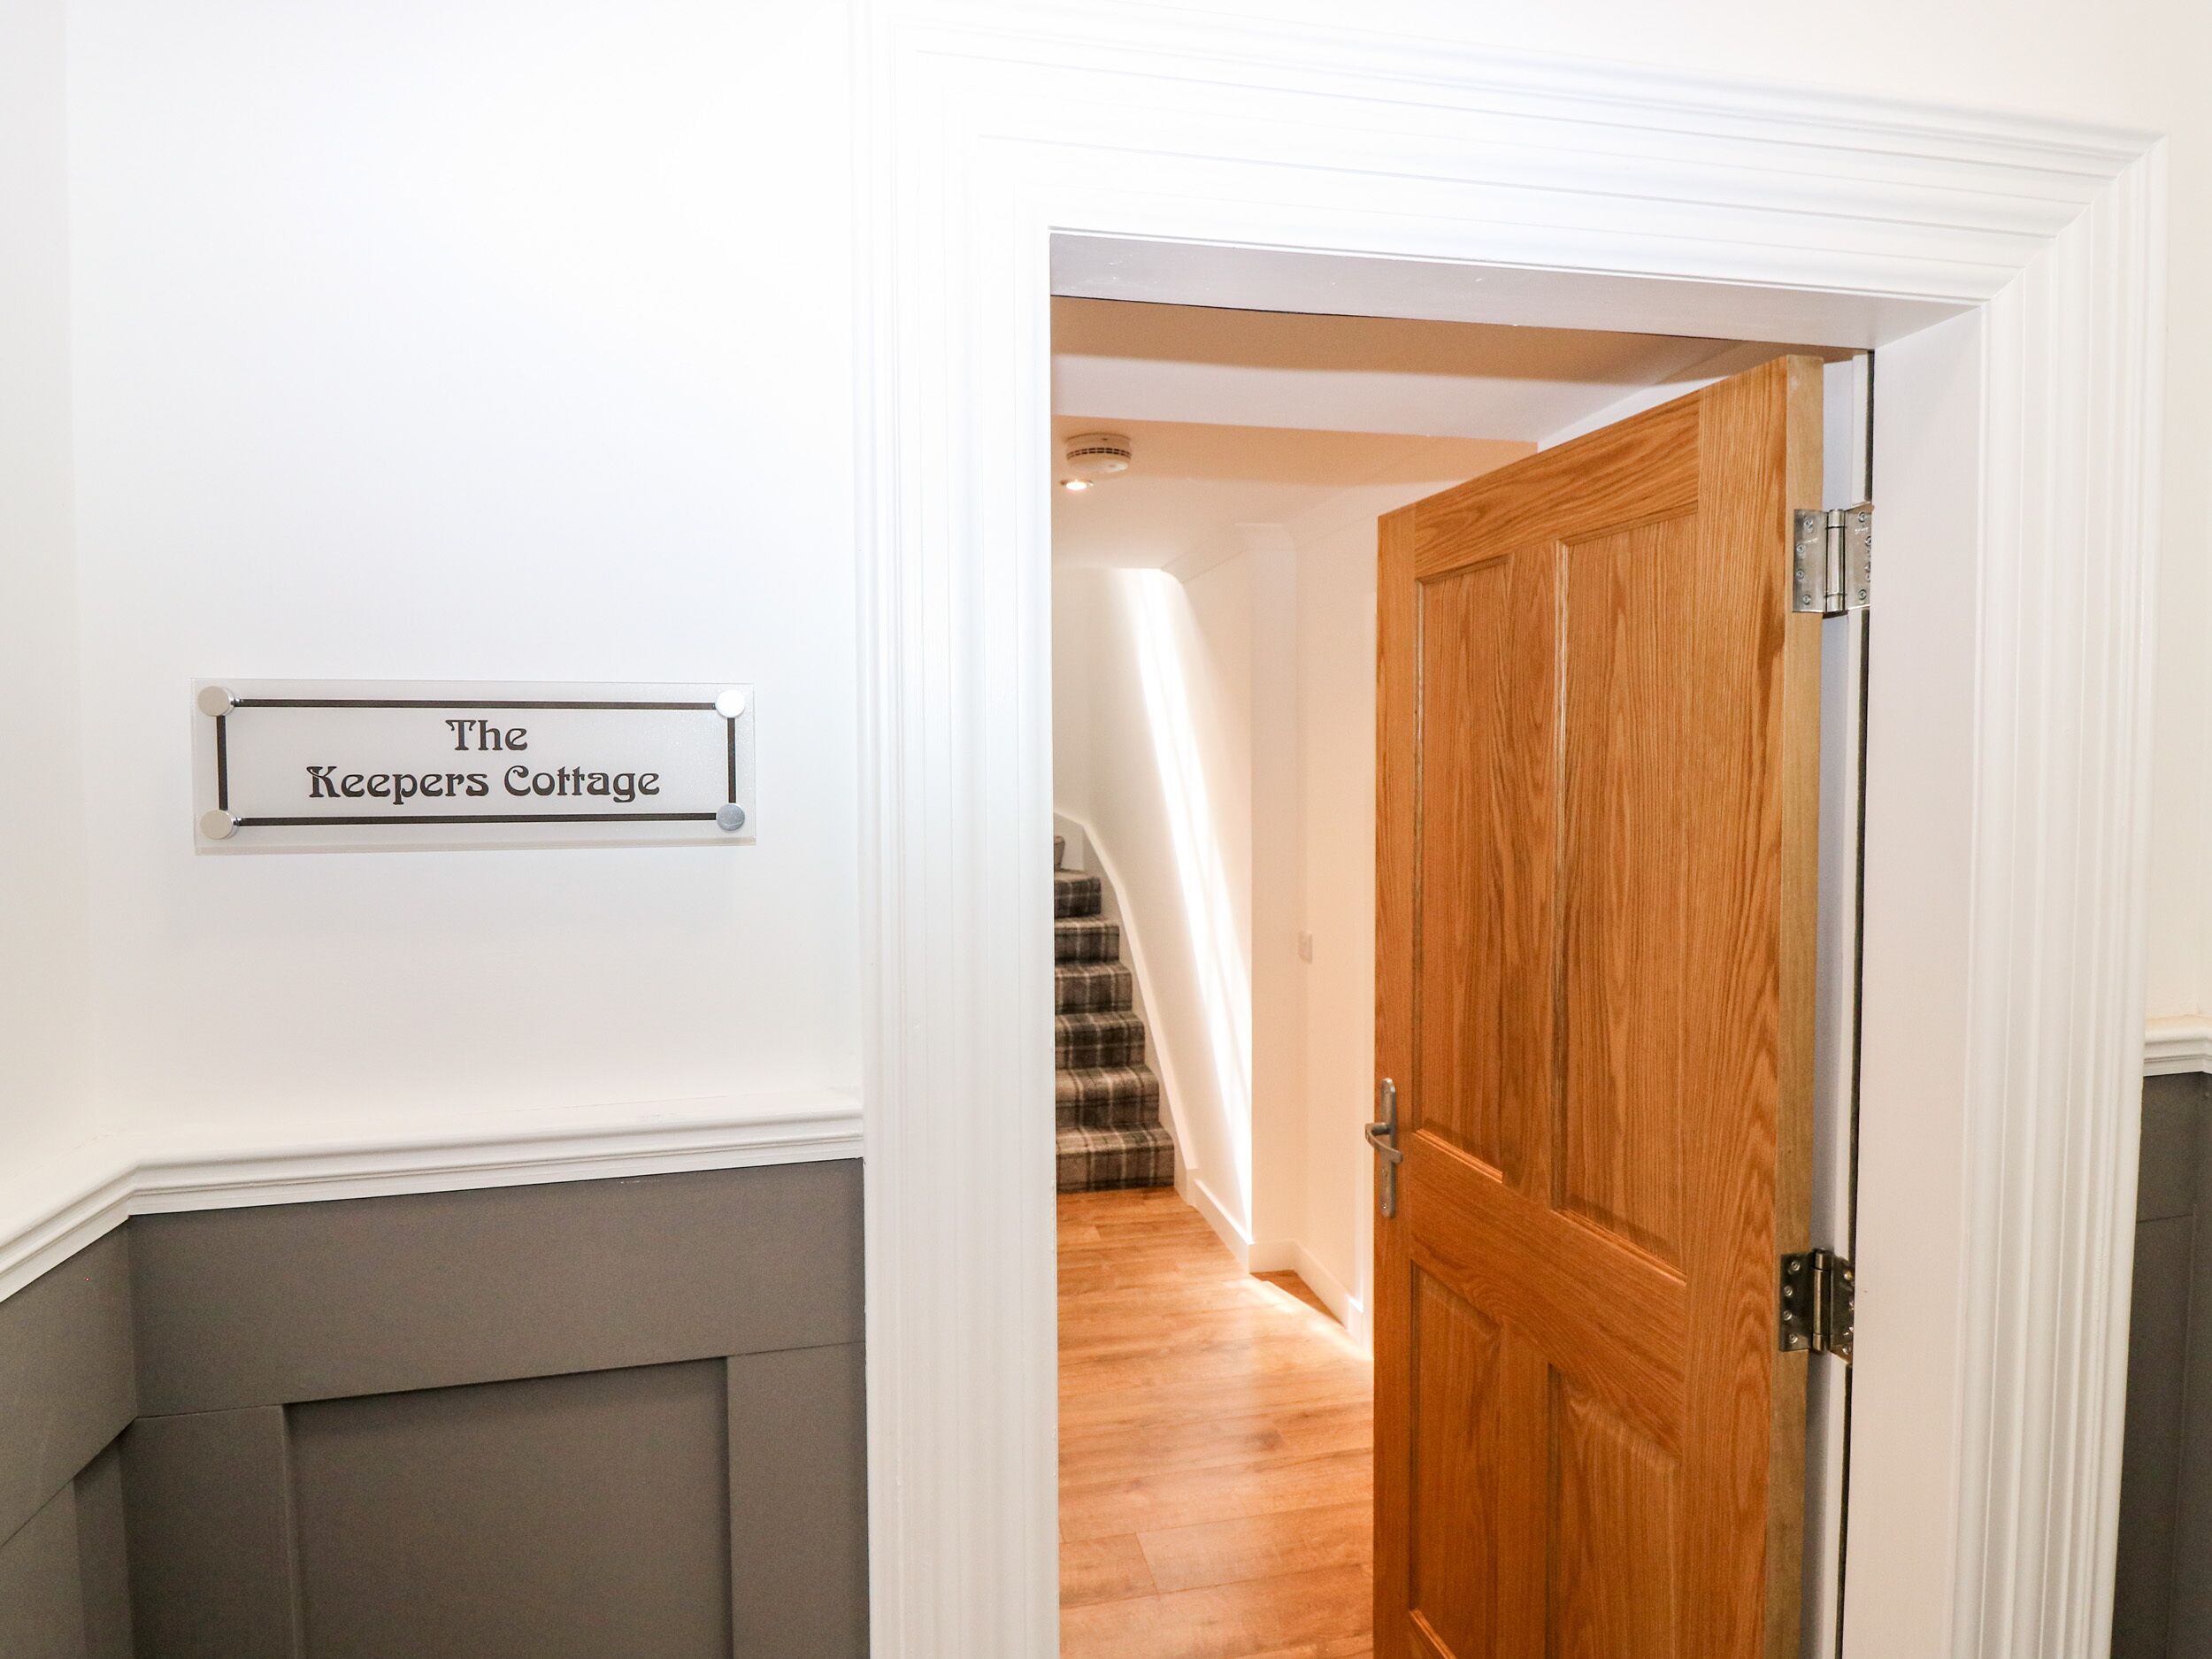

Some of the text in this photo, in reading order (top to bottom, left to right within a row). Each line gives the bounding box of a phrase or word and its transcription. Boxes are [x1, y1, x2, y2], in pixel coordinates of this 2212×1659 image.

[445, 719, 528, 751] The
[305, 764, 660, 806] Keepers Cottage
